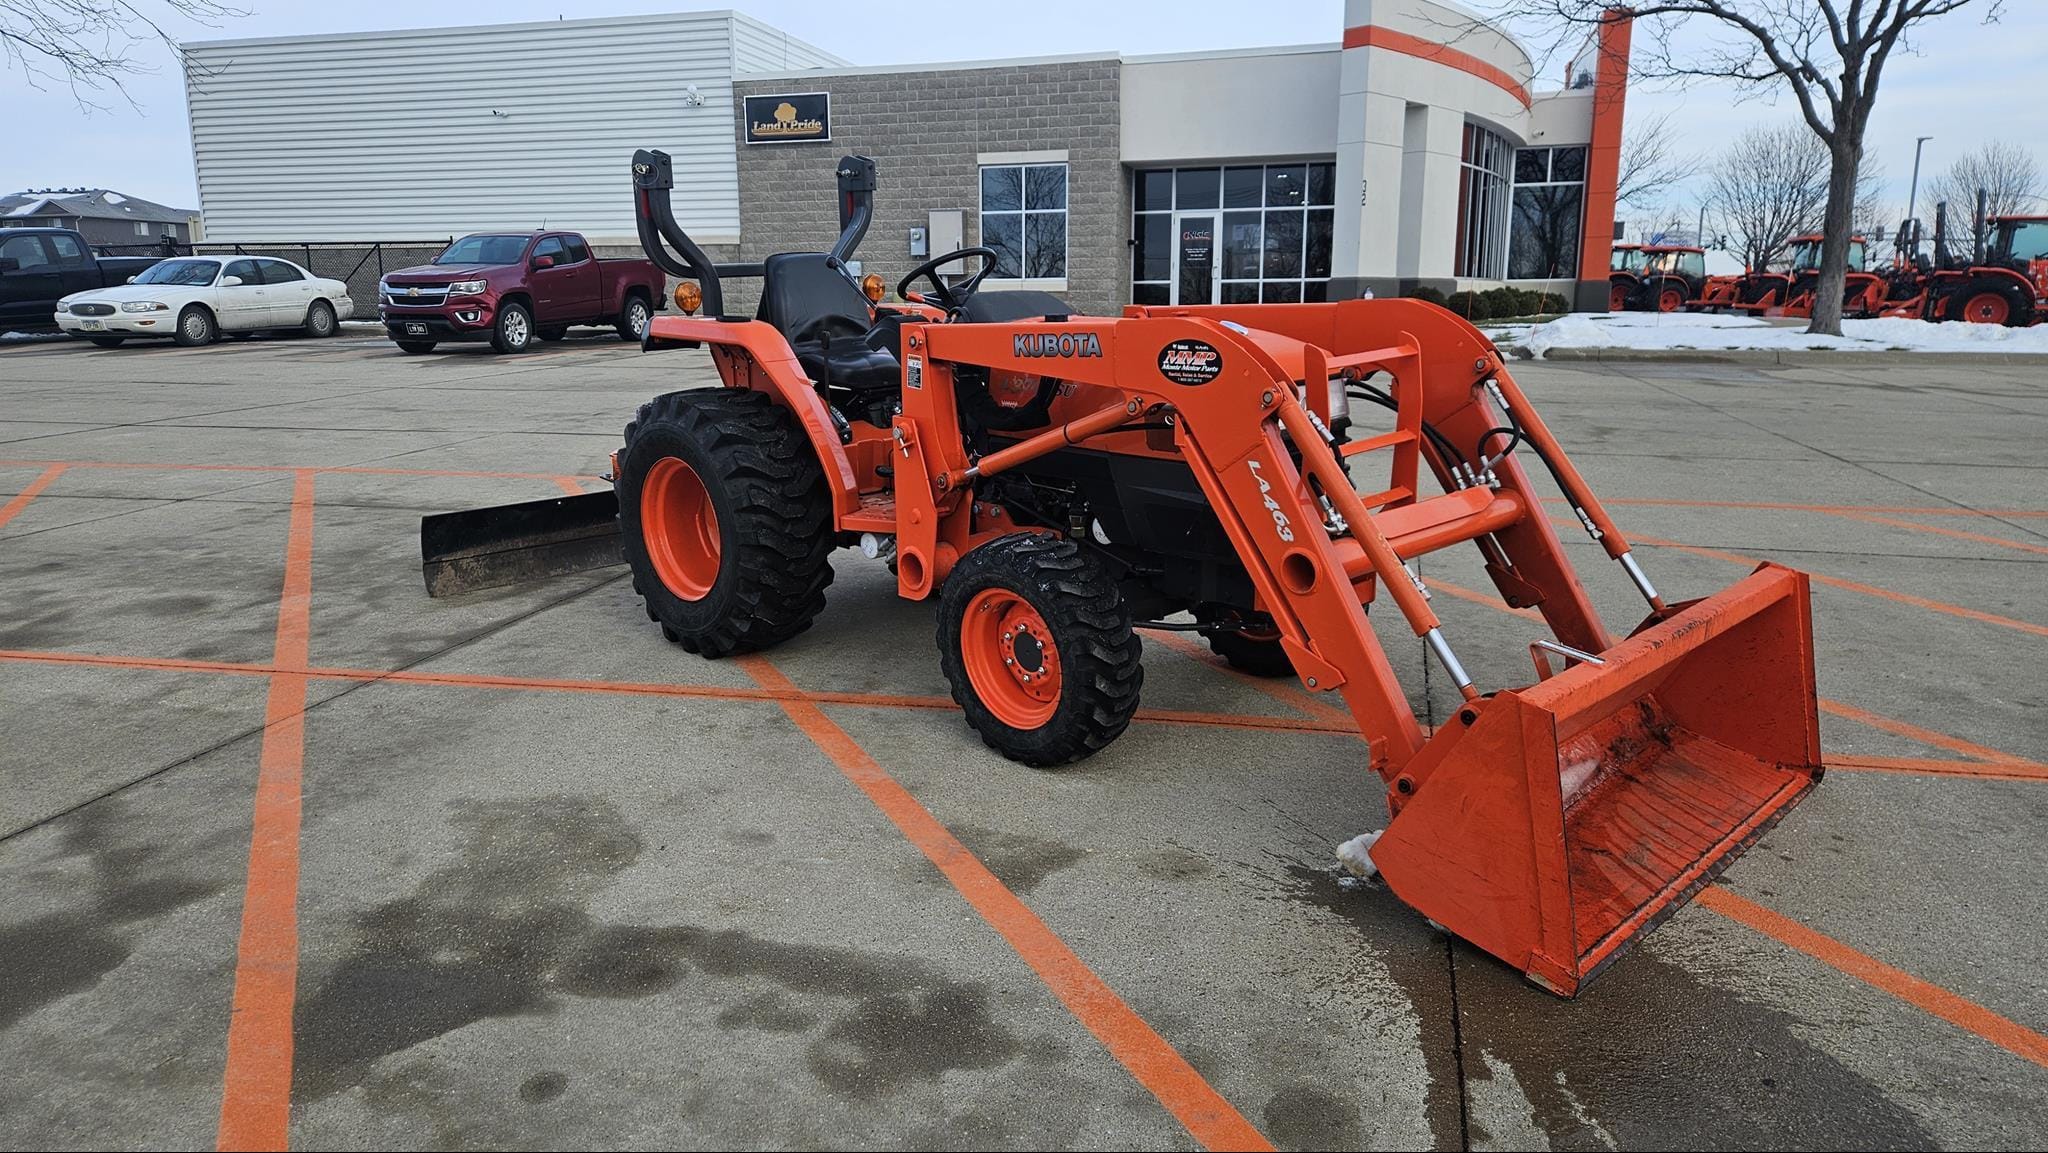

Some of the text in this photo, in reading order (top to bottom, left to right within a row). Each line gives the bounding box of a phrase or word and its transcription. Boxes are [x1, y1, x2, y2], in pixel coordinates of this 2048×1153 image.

[753, 119, 822, 131] Land Pride
[1013, 332, 1103, 358] KUBOTA
[1163, 350, 1217, 366] MMP
[1247, 460, 1294, 542] LA463
